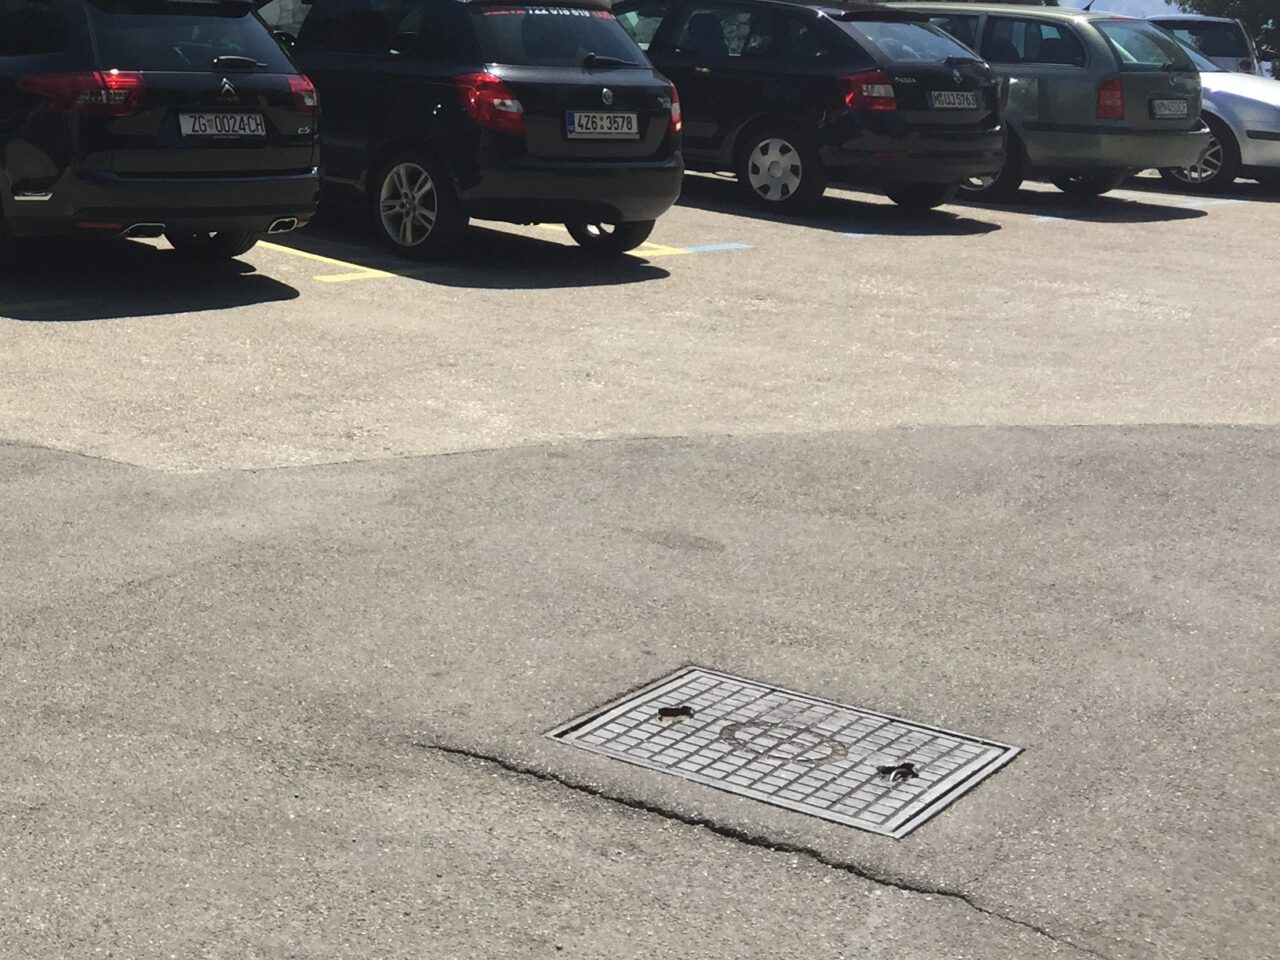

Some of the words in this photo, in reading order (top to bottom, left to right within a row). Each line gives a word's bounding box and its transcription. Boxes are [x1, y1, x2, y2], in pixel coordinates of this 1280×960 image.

[189, 115, 208, 133] ZG
[577, 115, 598, 131] 4Z6
[606, 115, 634, 131] 3578
